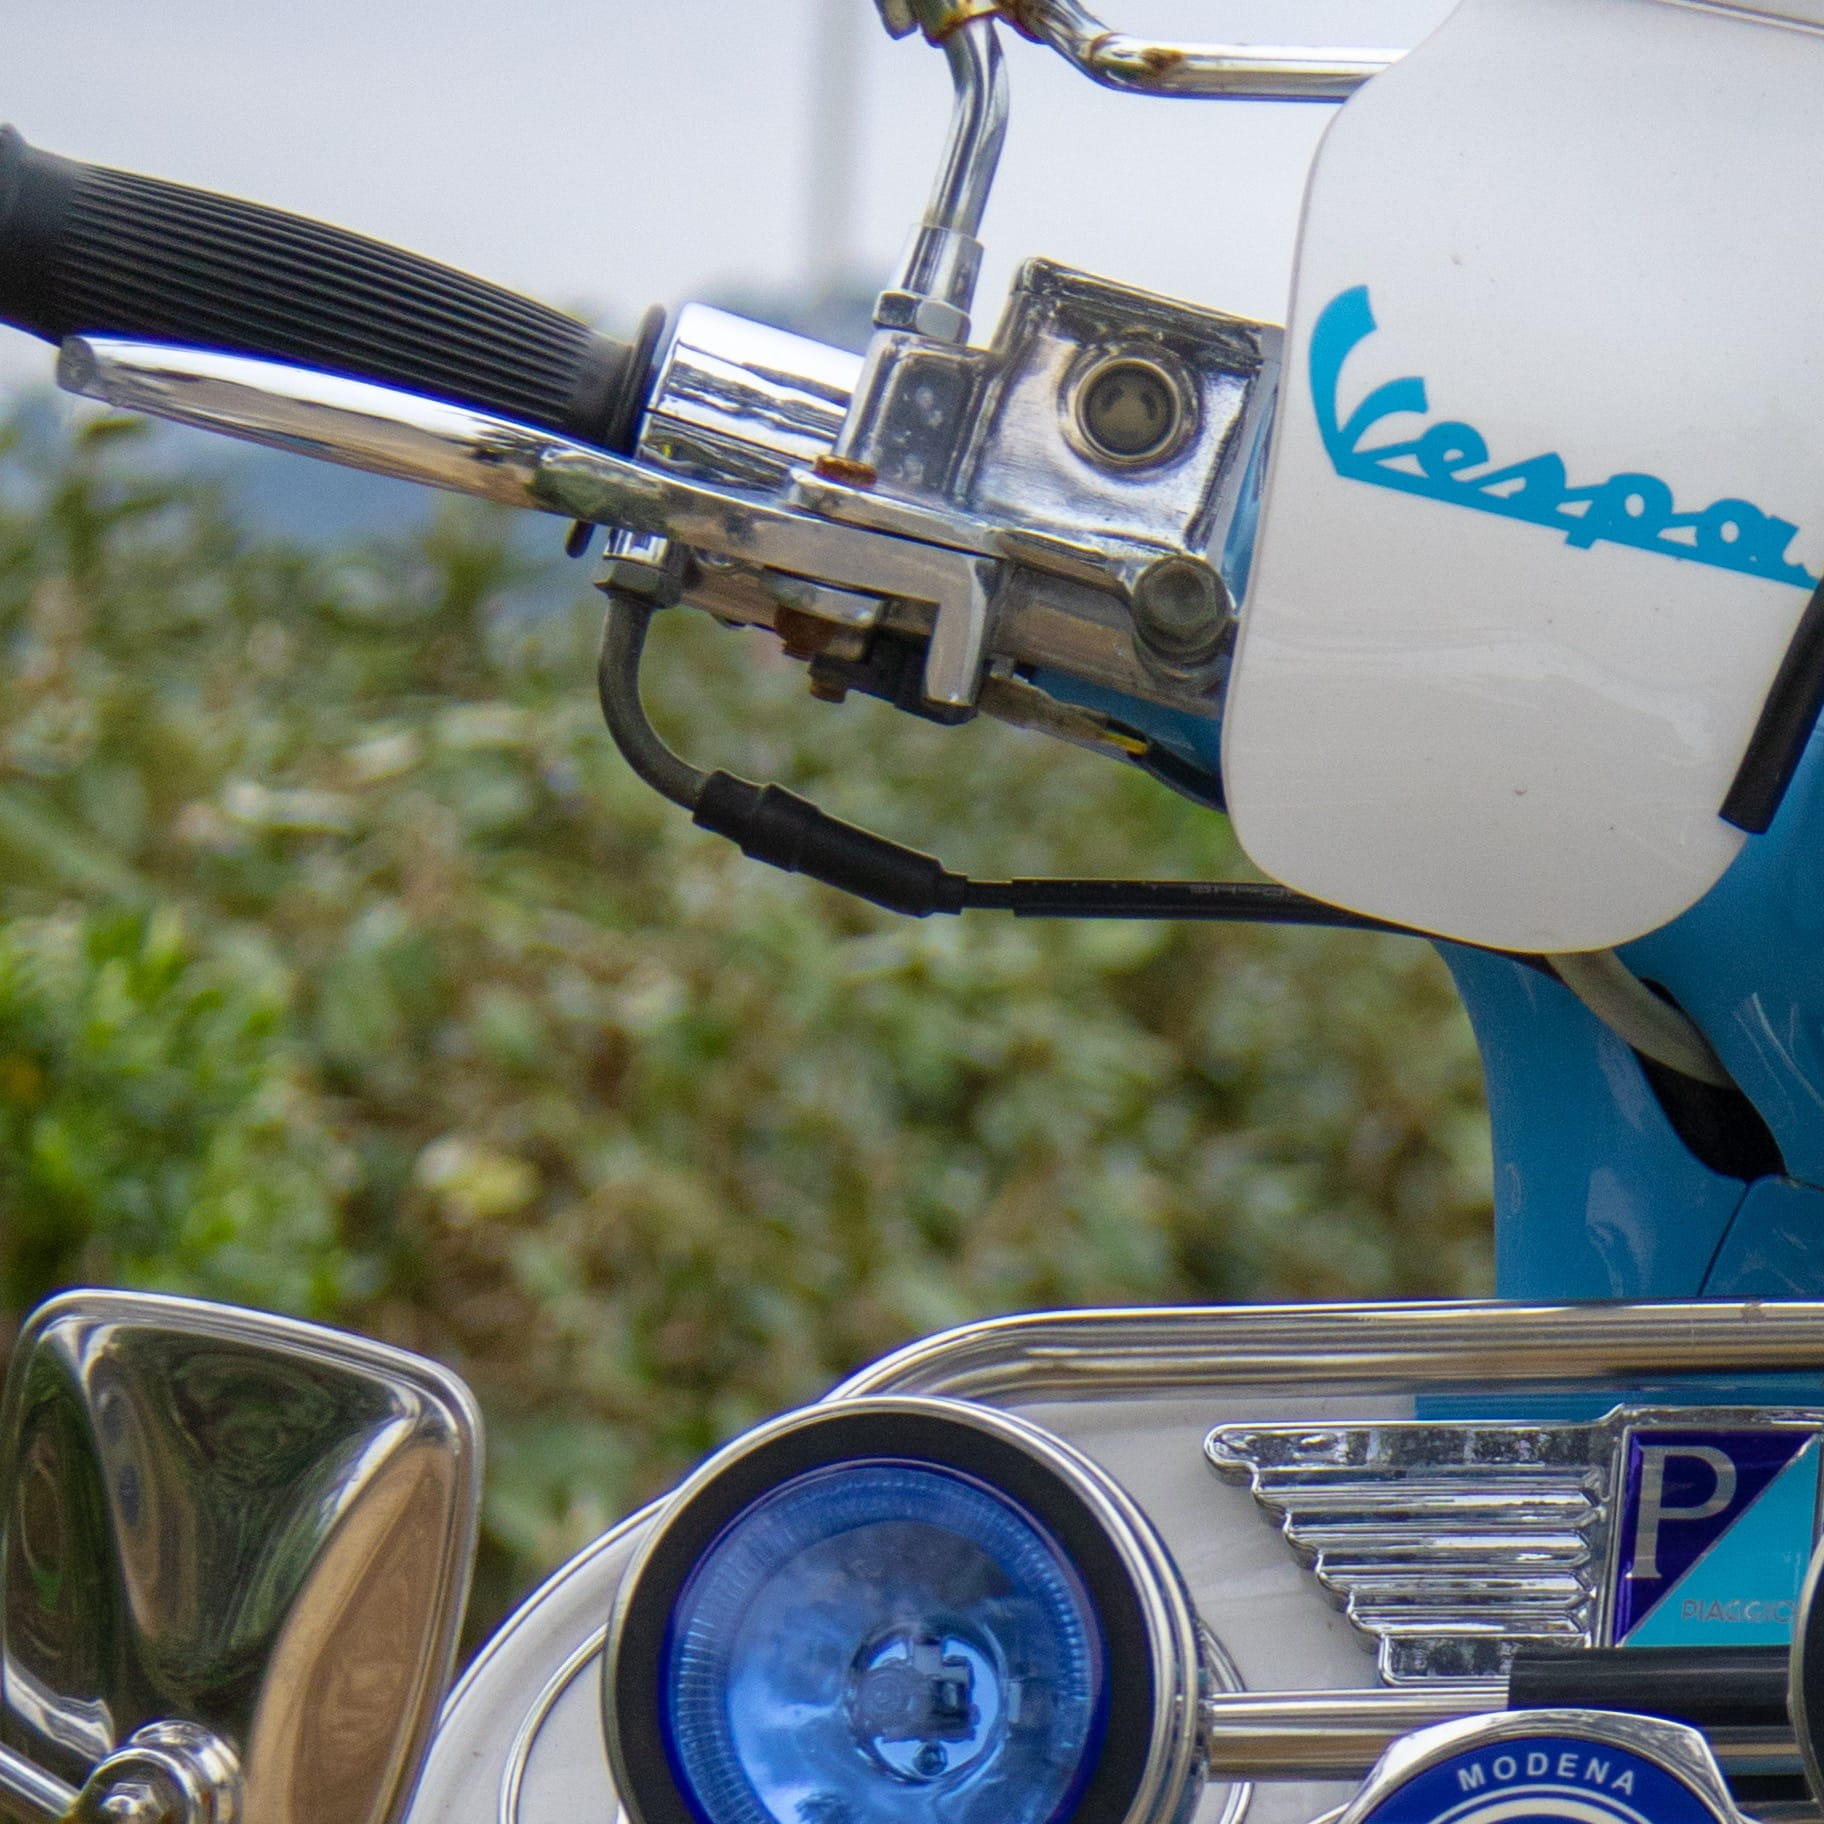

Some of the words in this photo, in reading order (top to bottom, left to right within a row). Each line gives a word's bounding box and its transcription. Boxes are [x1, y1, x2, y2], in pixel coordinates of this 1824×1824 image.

[1308, 284, 1821, 592] Vespa
[1625, 1444, 1738, 1579] P
[1681, 1598, 1797, 1624] PIAGGIO
[1456, 1752, 1636, 1796] MODENA
